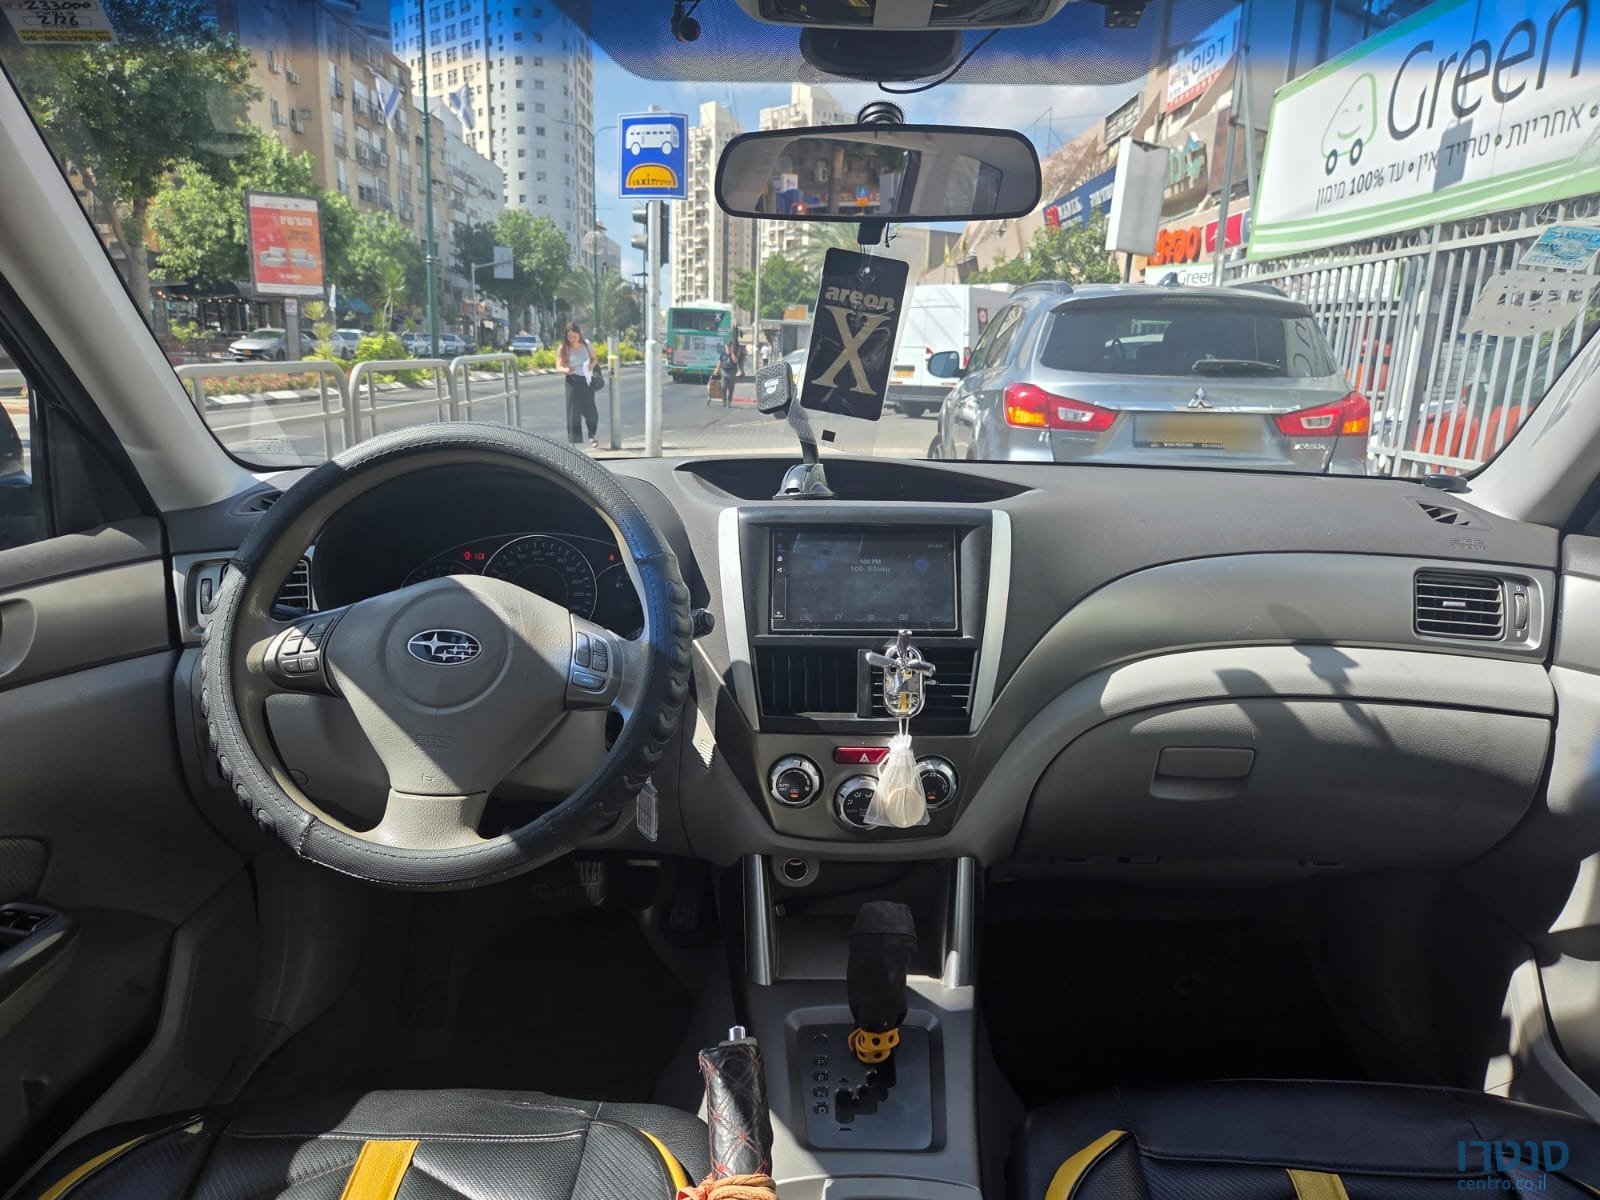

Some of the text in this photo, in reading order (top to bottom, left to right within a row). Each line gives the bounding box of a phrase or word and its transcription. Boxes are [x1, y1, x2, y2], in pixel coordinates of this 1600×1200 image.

[1192, 35, 1226, 74] דפוס
[1388, 0, 1590, 141] Green
[1315, 103, 1586, 211] אחריות טרייד אין עד 100% מימון
[824, 286, 895, 310] areon
[811, 305, 891, 395] X
